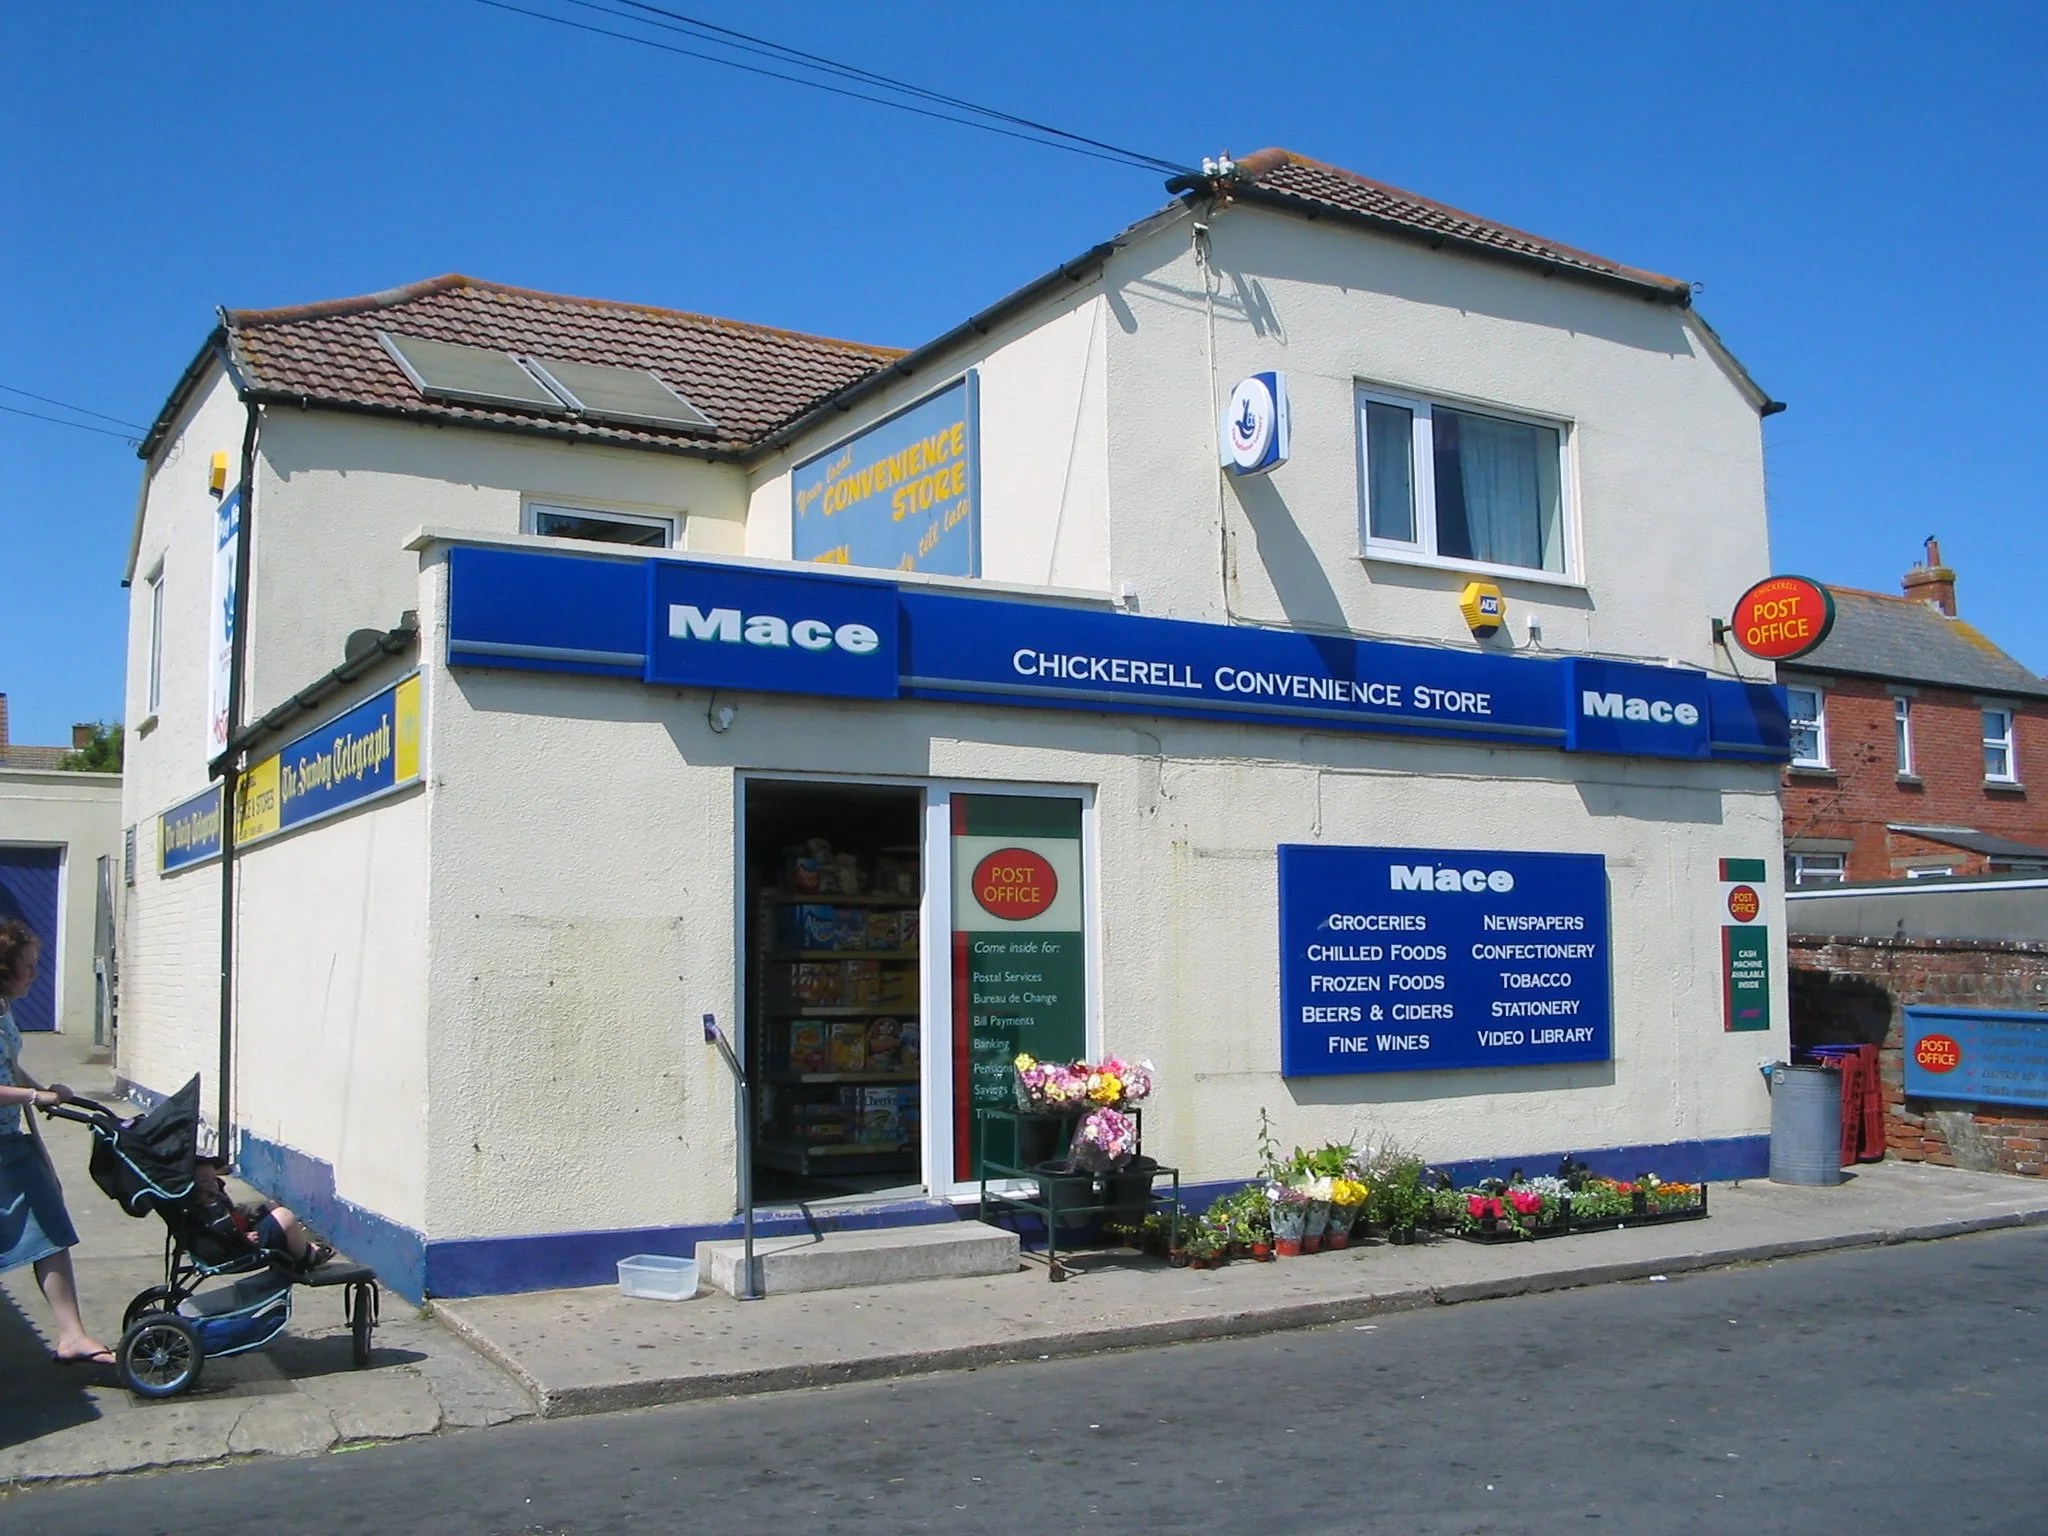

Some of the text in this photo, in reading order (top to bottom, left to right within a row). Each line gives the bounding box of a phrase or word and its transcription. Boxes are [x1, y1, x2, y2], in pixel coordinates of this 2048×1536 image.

[823, 421, 965, 516] CONVENIENCE
[892, 460, 966, 522] STORE
[1753, 597, 1800, 623] POST
[668, 603, 879, 654] Mace
[1747, 619, 1809, 645] OFFICE
[1013, 648, 1492, 714] CHICKERELL CONVENIENCE STORE
[1582, 690, 1699, 726] Mace
[333, 714, 390, 784] Telegraph
[992, 867, 1034, 883] POST
[1390, 865, 1515, 892] Mace
[984, 886, 1040, 903] OFFICE
[1734, 893, 1752, 902] POST
[1731, 903, 1756, 913] OFFICE
[1329, 913, 1427, 931] GROCERIES
[1483, 914, 1584, 931] NEWSPAPERS
[974, 941, 1006, 953] Come
[1009, 942, 1038, 953] inside
[1307, 944, 1447, 962] CHILLED FOODS
[1471, 943, 1596, 960] CONFECTIONERY
[1738, 950, 1757, 959] CASH
[1733, 961, 1763, 969] MACHINE
[973, 972, 1042, 983] Postal Services
[1500, 972, 1572, 989] TOBACCO
[1731, 970, 1766, 979] AVAILABLE
[1311, 974, 1446, 993] FROZEN FOODS
[1738, 981, 1760, 989] INSIDE
[973, 992, 1057, 1005] Bureau de Change
[1302, 1003, 1454, 1024] BEERS & CIDERS
[1491, 1000, 1581, 1018] STATIONERY
[974, 1016, 1034, 1028] Bill Payments
[973, 1039, 1010, 1051] Banking
[1328, 1034, 1430, 1054] FINE WINES
[1477, 1027, 1595, 1047] VIDEO LIBRARY
[1921, 1039, 1951, 1052] POST
[1917, 1053, 1956, 1066] OFFICE
